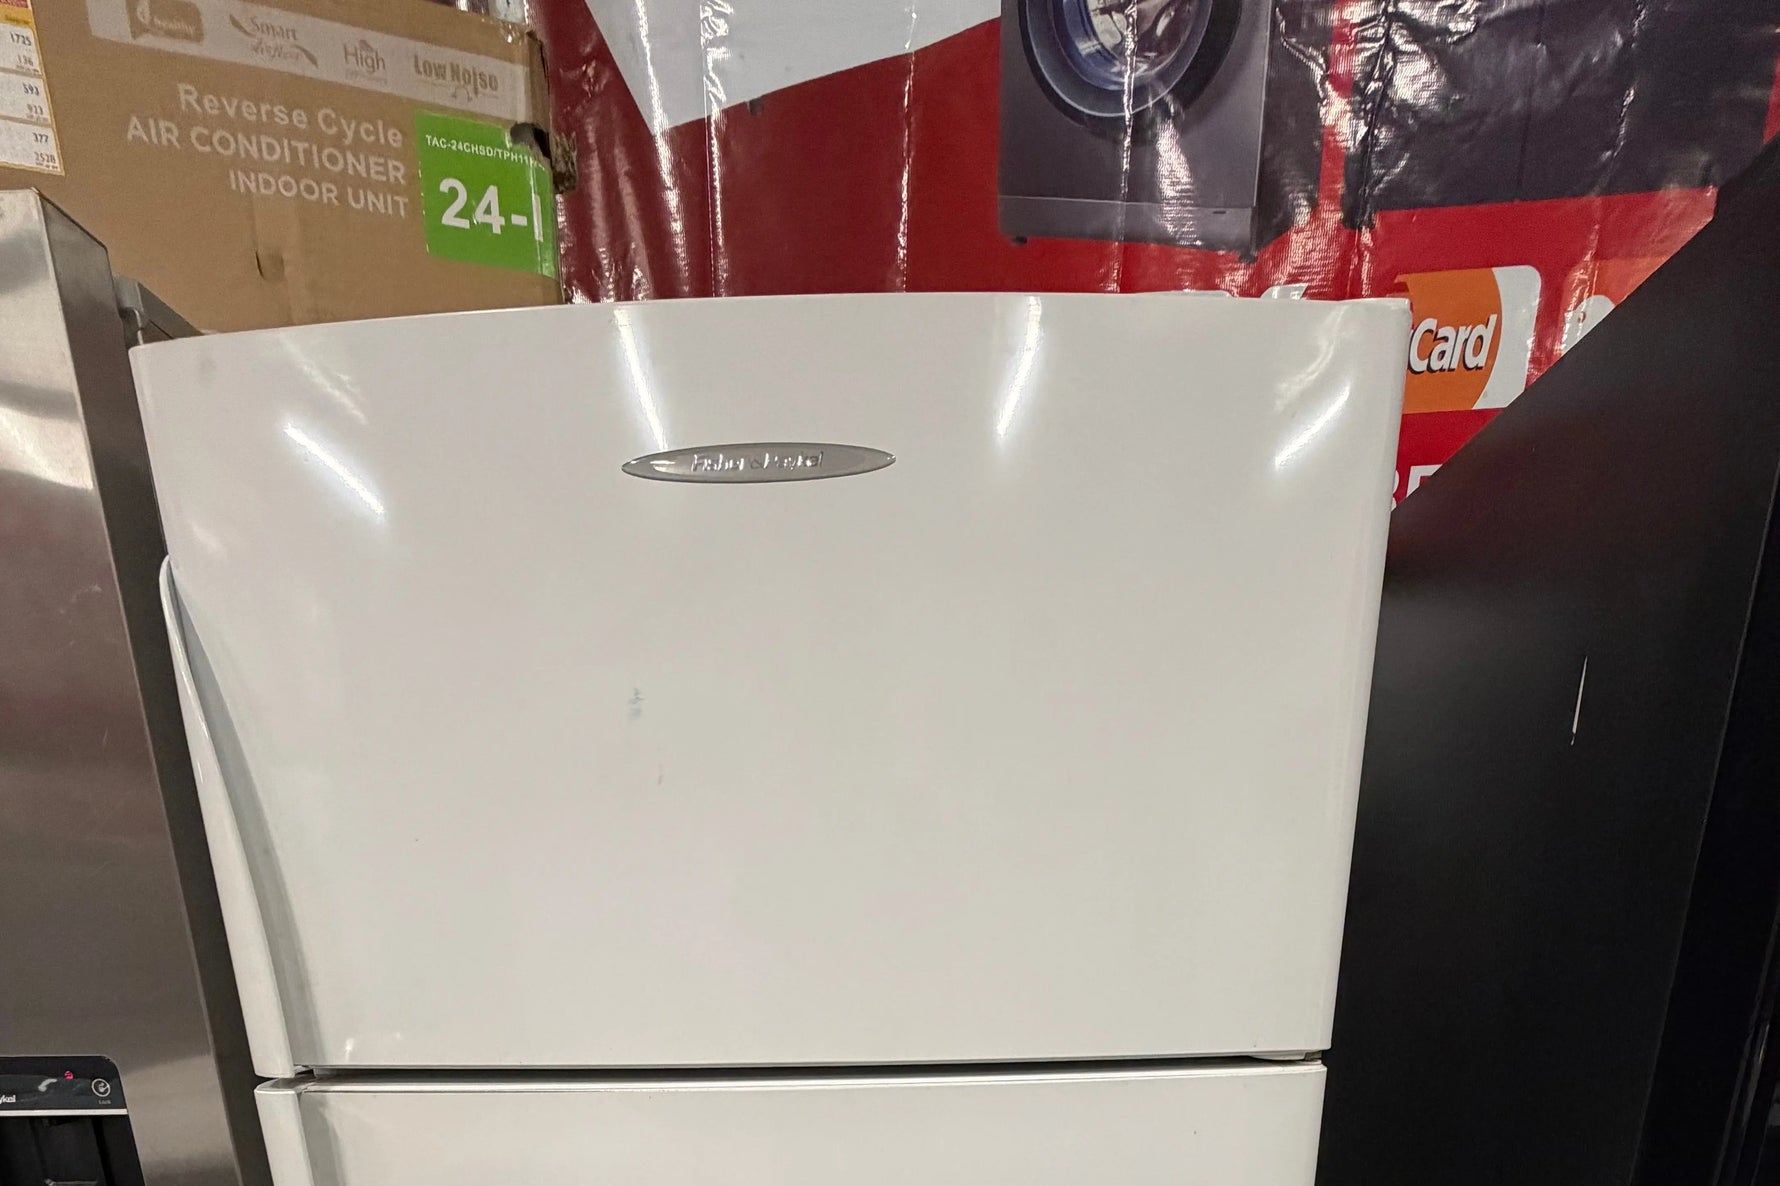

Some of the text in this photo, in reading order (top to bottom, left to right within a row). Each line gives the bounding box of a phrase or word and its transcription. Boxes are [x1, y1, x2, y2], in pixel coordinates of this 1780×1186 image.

[343, 44, 386, 74] High
[414, 54, 447, 81] Low
[177, 82, 403, 148] Reverse Cycle
[126, 115, 406, 185] AIR CONDITIONER
[228, 168, 409, 219] INDOOR UNIT
[1407, 313, 1498, 375] Card
